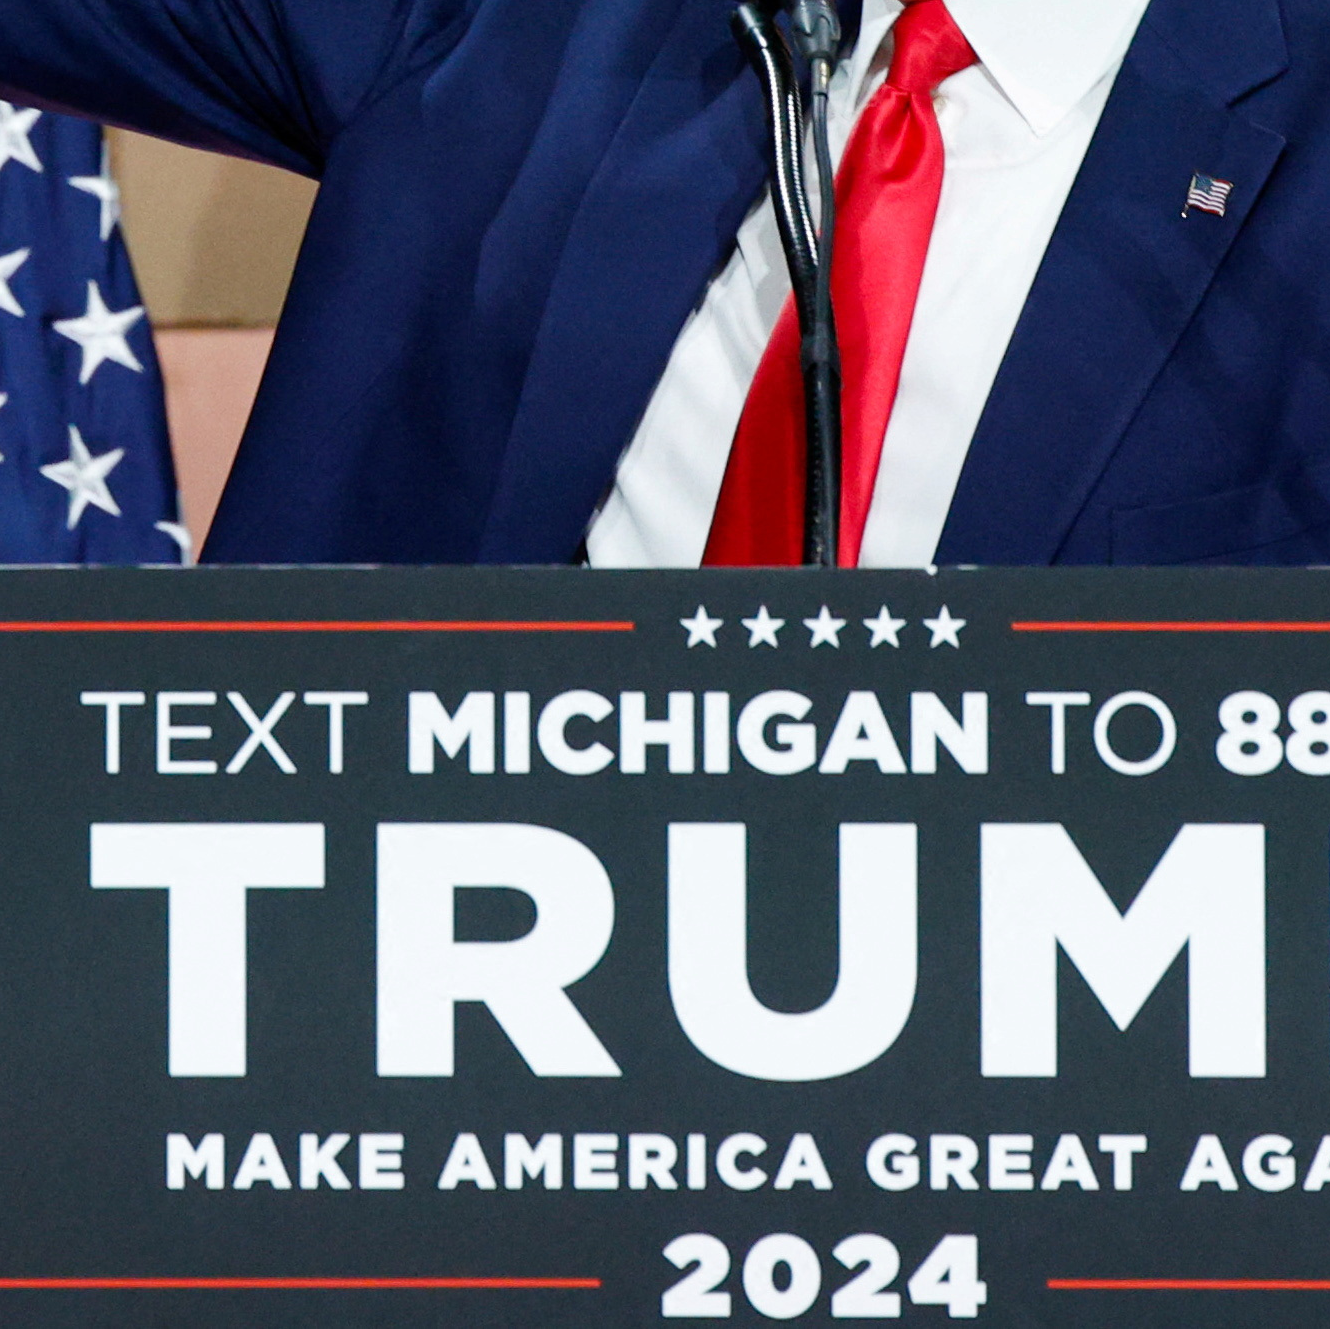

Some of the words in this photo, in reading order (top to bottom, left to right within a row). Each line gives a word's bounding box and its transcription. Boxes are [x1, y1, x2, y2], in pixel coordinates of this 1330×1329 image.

[81, 691, 369, 774] TEXT
[408, 689, 989, 775] MICHIGAN
[1025, 690, 1177, 776] TO
[166, 1132, 405, 1190] MAKE
[438, 1132, 833, 1191] AMERICA
[866, 1133, 1148, 1191] GREAT
[662, 1233, 987, 1319] 2024
